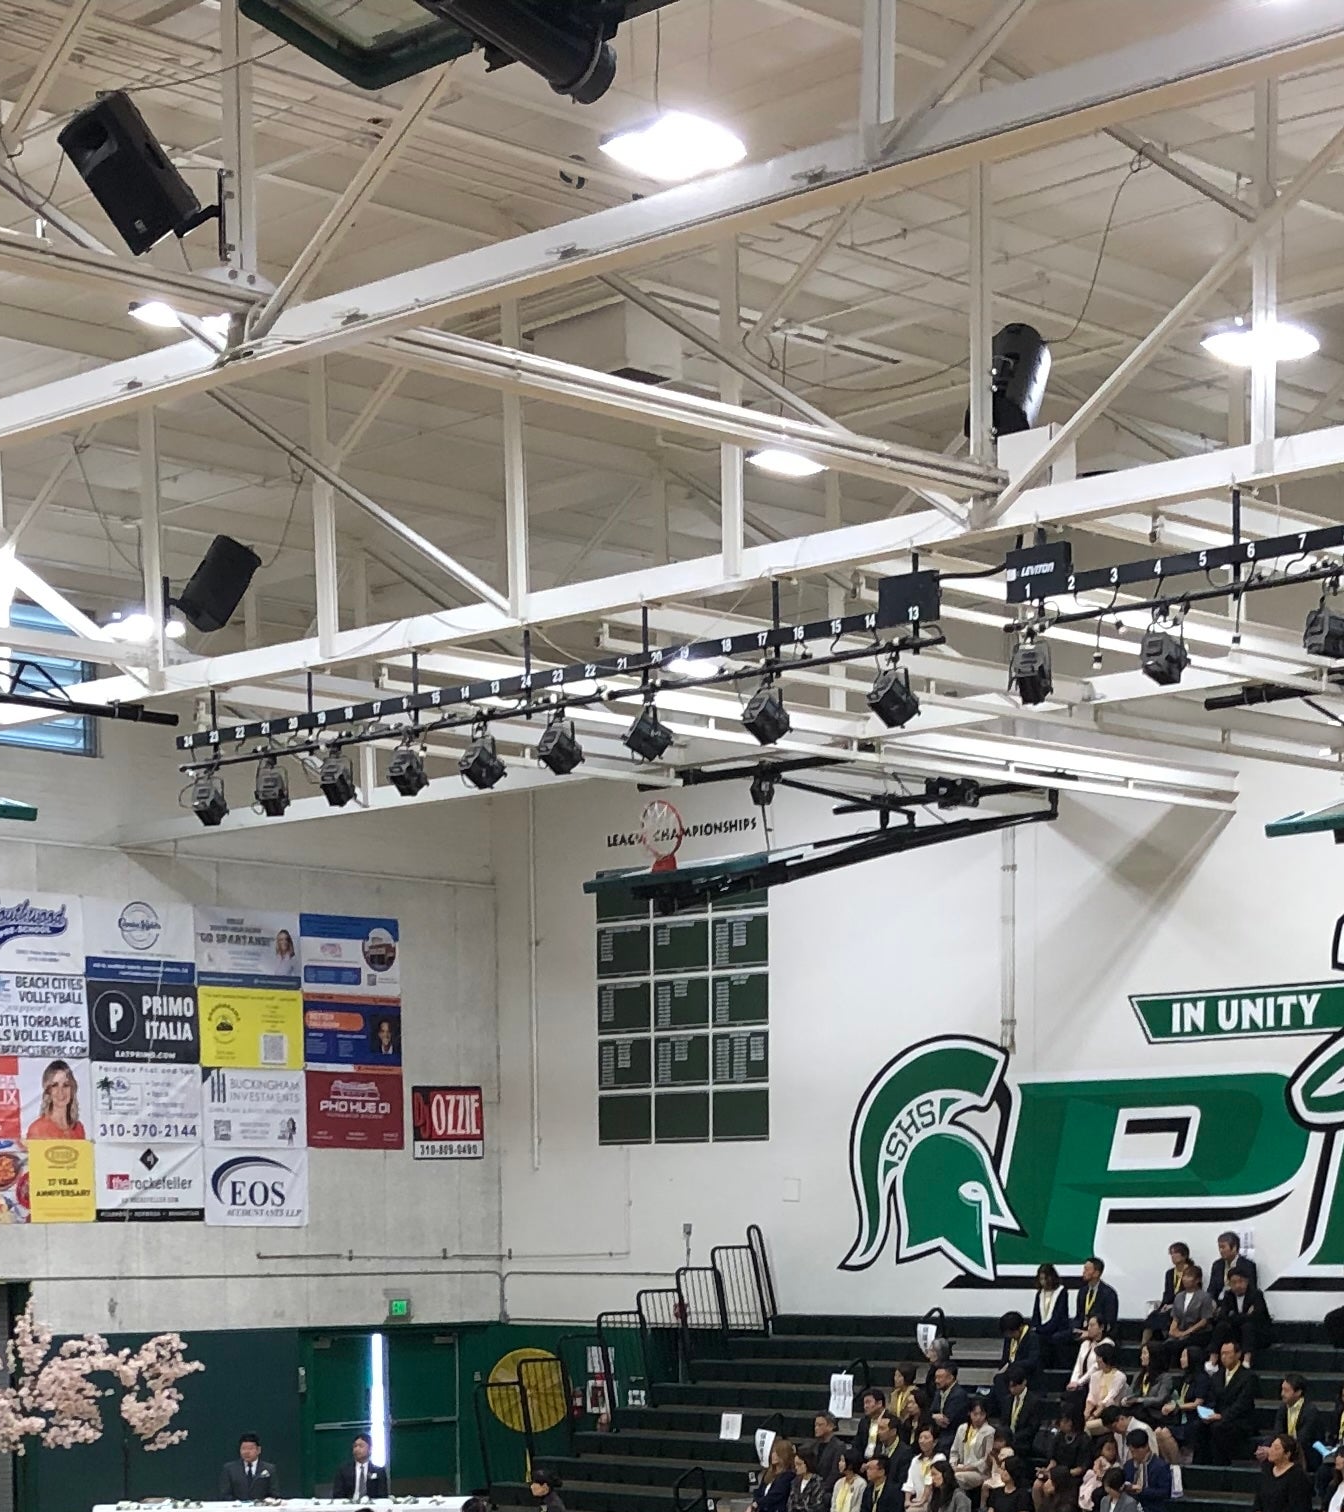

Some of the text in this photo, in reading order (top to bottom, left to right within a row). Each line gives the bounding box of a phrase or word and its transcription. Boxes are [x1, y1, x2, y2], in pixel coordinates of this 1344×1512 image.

[1025, 583, 1031, 598] 1
[1067, 575, 1076, 590] 2
[1109, 567, 1118, 583] 3
[1153, 560, 1162, 575] 4
[1199, 552, 1206, 567] 5
[1247, 543, 1255, 558] 6
[1298, 534, 1306, 549] 7
[908, 606, 919, 621] 13
[16, 976, 83, 990] BEACH CITIES
[18, 991, 83, 1005] VOLLEYBALL
[142, 996, 194, 1017] PRIMO
[22, 1015, 81, 1028] TORRANCE
[109, 1002, 123, 1033] P
[1171, 993, 1321, 1033] IN UNITY
[14, 1029, 87, 1042] VOLLEYBALL
[145, 1020, 193, 1041] ITALIA
[230, 1079, 300, 1091] BUCKINGHAM
[230, 1091, 300, 1103] INVESTMENTS
[431, 1094, 480, 1135] OZZIE
[100, 1124, 197, 1137] 310-370-2144
[885, 1099, 938, 1163] SHS
[231, 1180, 286, 1206] EOS
